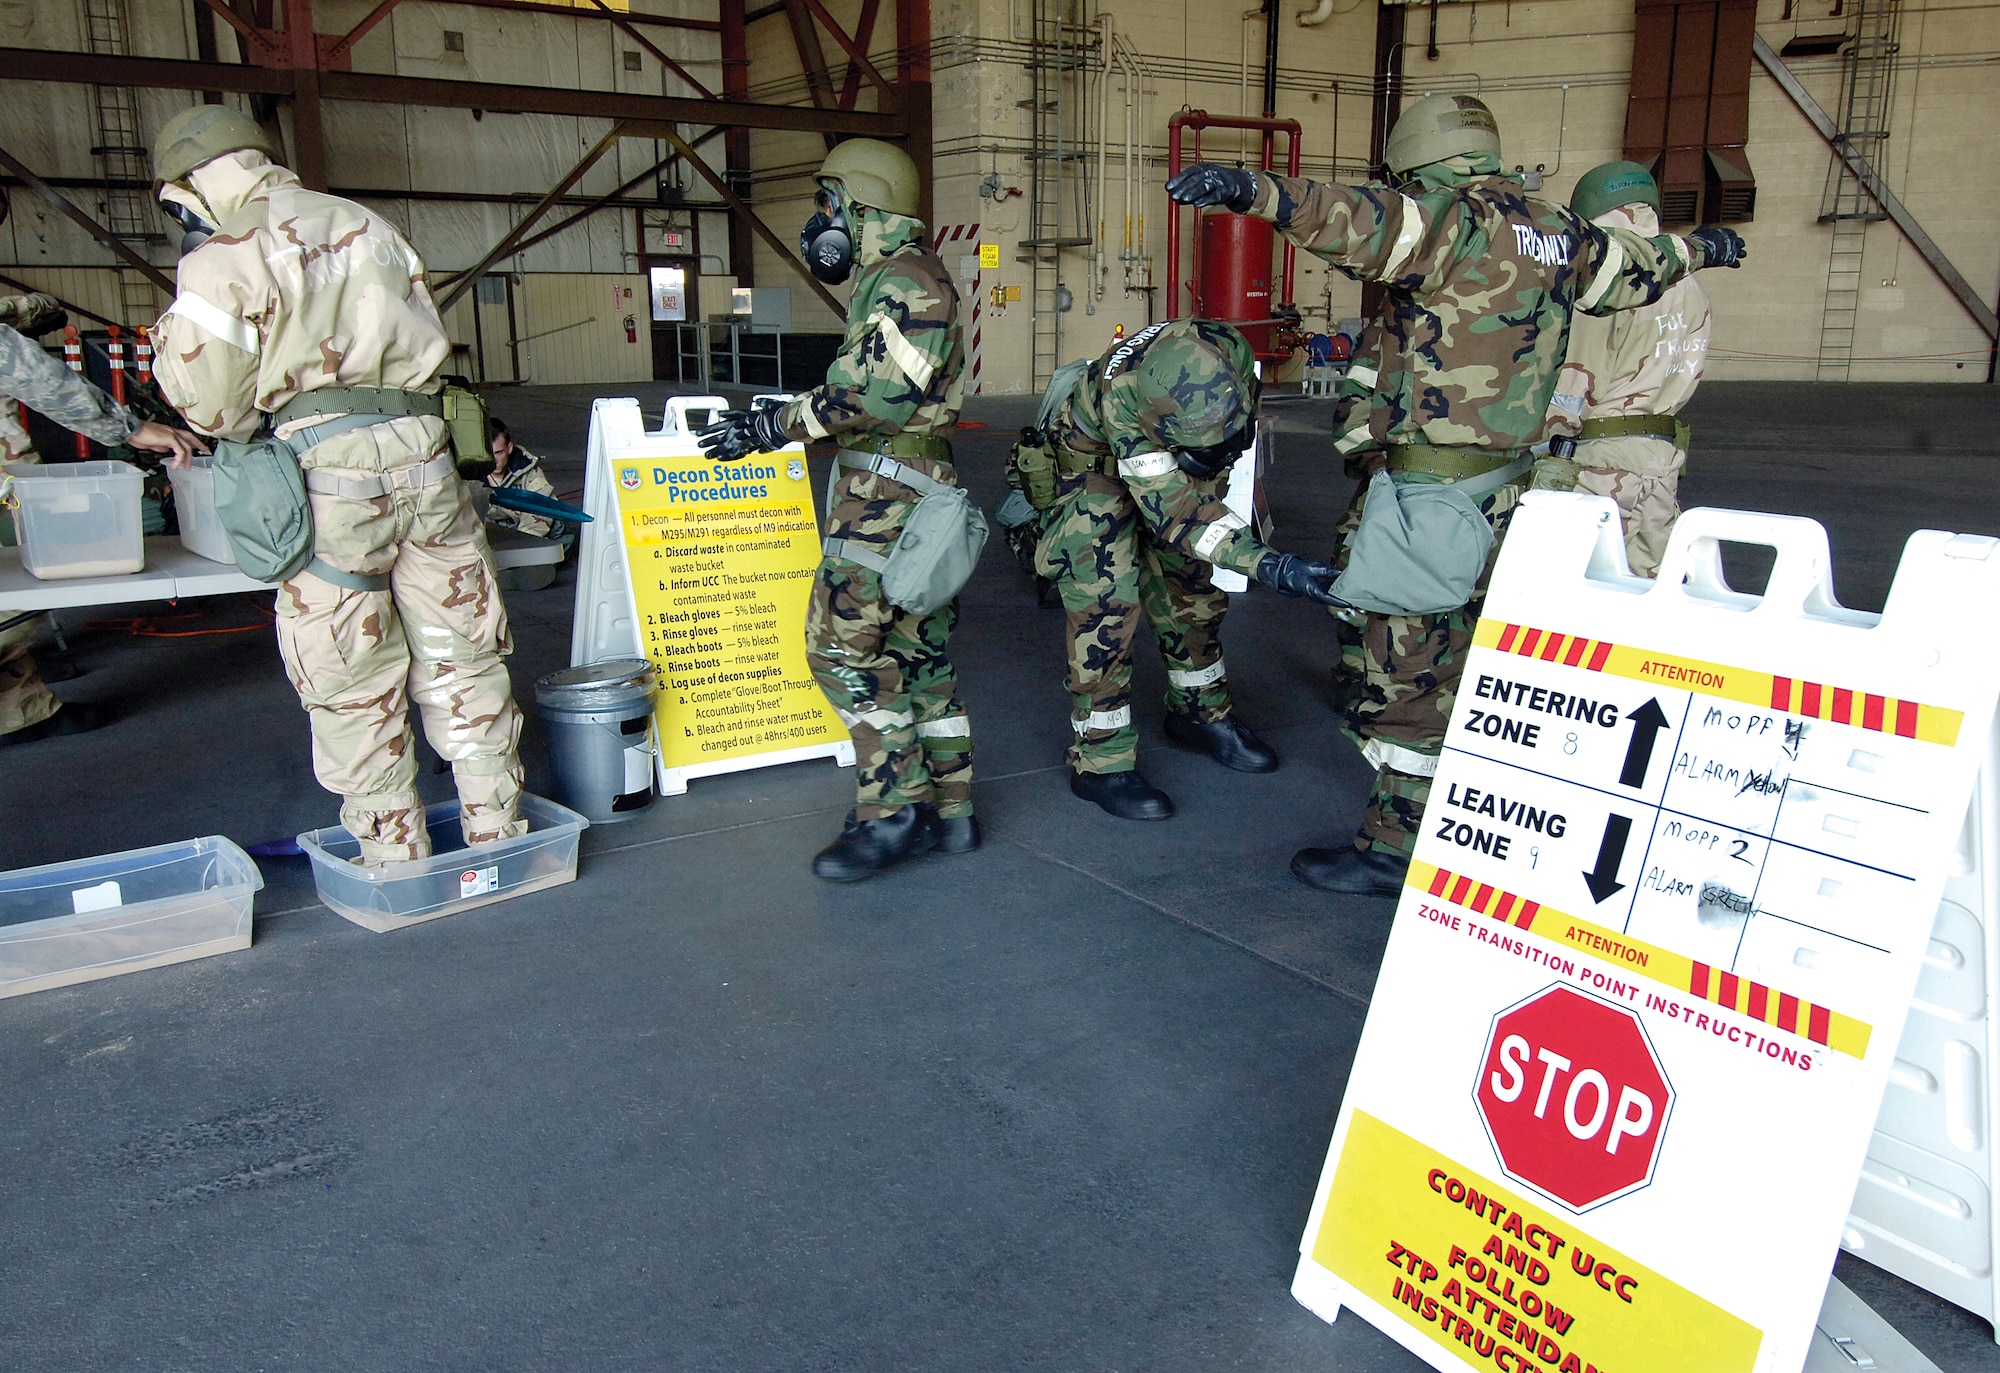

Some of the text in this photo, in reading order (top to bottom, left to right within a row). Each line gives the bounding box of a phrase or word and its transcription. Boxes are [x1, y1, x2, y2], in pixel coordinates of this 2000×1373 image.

[667, 234, 679, 244] EXIT
[653, 463, 777, 485] Decon Station
[668, 482, 768, 503] Procedures
[631, 515, 639, 526] 1.
[642, 513, 669, 526] Decon
[684, 511, 695, 523] All
[696, 509, 737, 524] personnel
[738, 508, 757, 519] must
[759, 506, 783, 518] decon
[784, 505, 802, 516] with
[661, 520, 816, 541] M295/M291 regardless of M9 indication
[653, 537, 791, 559] a. Discard waste in contaminated
[659, 580, 668, 590] b.
[671, 578, 700, 590] Inform
[702, 575, 720, 587] UCC
[722, 574, 738, 585] The
[739, 571, 767, 584] bucket
[768, 571, 786, 581] now
[669, 560, 725, 574] waste bucket
[673, 589, 757, 606] contaminated waste
[647, 615, 657, 625] 2.
[659, 611, 690, 624] Bleach
[692, 608, 721, 623] gloves
[735, 605, 748, 617] 5%
[749, 602, 777, 615] bleach
[650, 631, 660, 641] 3.
[662, 628, 688, 640] Rinse
[689, 625, 718, 641] gloves
[732, 621, 753, 633] rinse
[755, 619, 777, 630] water
[653, 647, 662, 658] 4.
[665, 643, 695, 657] Bleach
[697, 641, 723, 653] boots
[737, 637, 751, 649] 5%
[752, 634, 779, 647] bleach
[656, 663, 666, 674] 5.
[668, 661, 693, 673] Rinse
[695, 657, 721, 669] boots
[735, 654, 755, 665] rinse
[757, 651, 780, 663] water
[1640, 661, 1725, 689] ATTENTION
[670, 678, 689, 691] Log
[690, 676, 706, 686] use
[707, 673, 717, 684] of
[718, 669, 745, 683] decon
[746, 666, 782, 681] supplies
[679, 695, 688, 705] a.
[690, 686, 732, 703] Complete
[782, 677, 816, 690] Through
[695, 701, 755, 719] Accountability
[1475, 674, 1619, 728] ENTERING
[685, 708, 823, 737] b. Bleach and rinse water must be
[1464, 709, 1578, 755] ZONE 8
[701, 724, 827, 752] changed out @ 48hrs/400 users
[1421, 757, 1438, 772] SI
[1675, 752, 1739, 786] ALARM
[1446, 783, 1567, 838] LEAVING
[1436, 817, 1540, 870] ZONE 9
[1663, 821, 1756, 867] MOPP 2
[1645, 866, 1694, 897] ALARM
[1565, 925, 1649, 968] ATTENTION
[1418, 904, 1814, 1072] ZONE TRANSITION POINT INSTRUCTIONS
[1490, 1033, 1655, 1156] STOP
[1427, 1168, 1639, 1303] CONTACT UCC
[1386, 1239, 1439, 1284] ZTP
[1482, 1234, 1550, 1286] AND
[1447, 1244, 1575, 1336] FOLLOW
[1392, 1276, 1542, 1373] INSTRUCT
